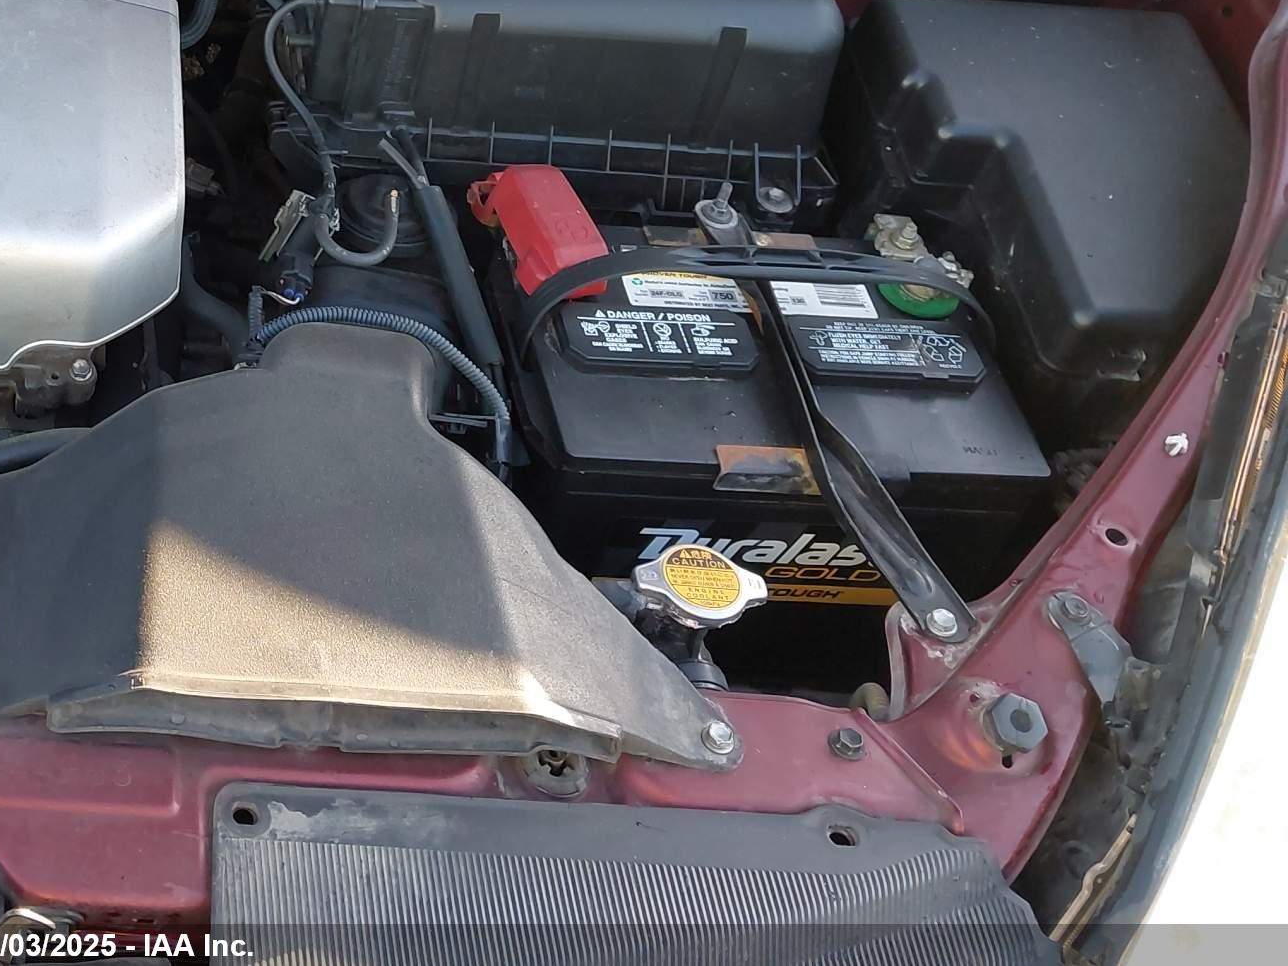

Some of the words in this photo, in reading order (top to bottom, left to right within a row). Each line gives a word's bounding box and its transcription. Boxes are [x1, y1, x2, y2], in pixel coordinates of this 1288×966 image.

[711, 291, 734, 301] 750
[606, 310, 656, 320] DANGER
[666, 313, 711, 322] POISON
[638, 527, 874, 568] Dralas
[671, 557, 726, 569] CAUTION
[764, 566, 882, 582] GOLD
[686, 592, 729, 601] COOLANT
